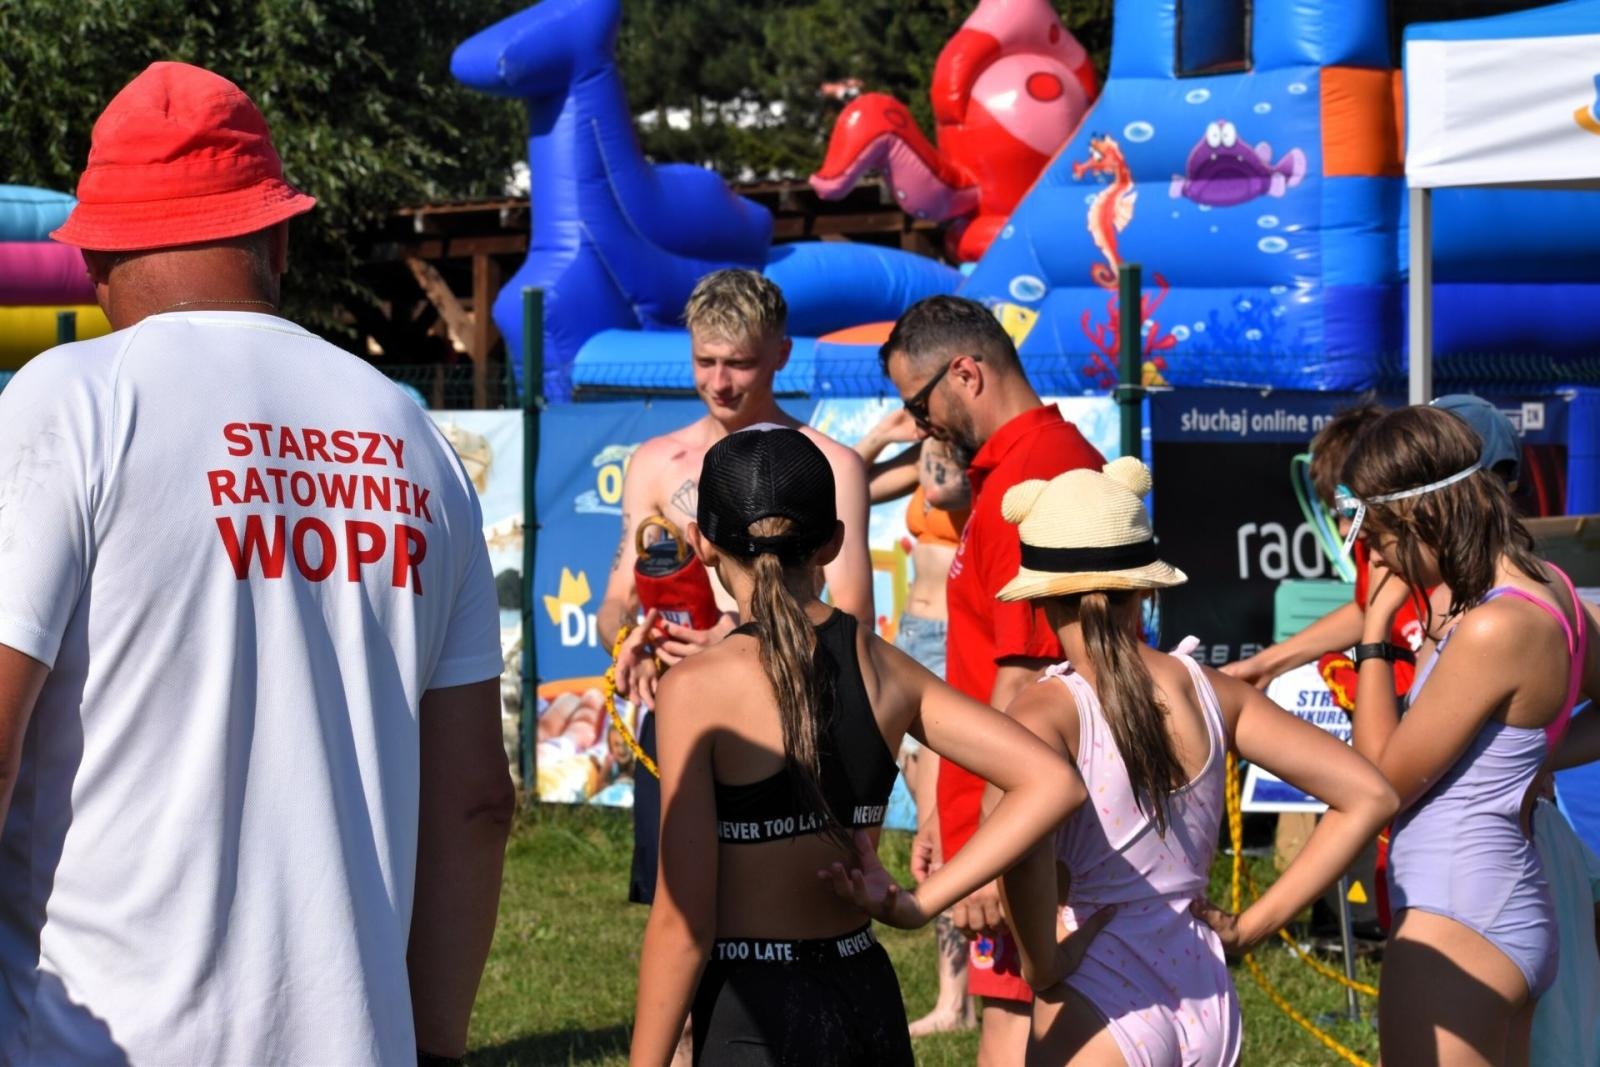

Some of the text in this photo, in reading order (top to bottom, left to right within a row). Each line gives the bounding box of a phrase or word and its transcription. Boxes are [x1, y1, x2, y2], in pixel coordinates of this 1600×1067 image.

[1181, 408, 1248, 437] słuchaj
[1252, 409, 1308, 433] online
[223, 423, 404, 469] STARSZY
[207, 467, 433, 524] RATOWNIK
[215, 514, 427, 596] WOPR
[1238, 521, 1338, 579] rad
[1240, 643, 1264, 660] F
[764, 816, 794, 837] TOO
[717, 942, 748, 960] TOO
[836, 931, 872, 958] NEVER
